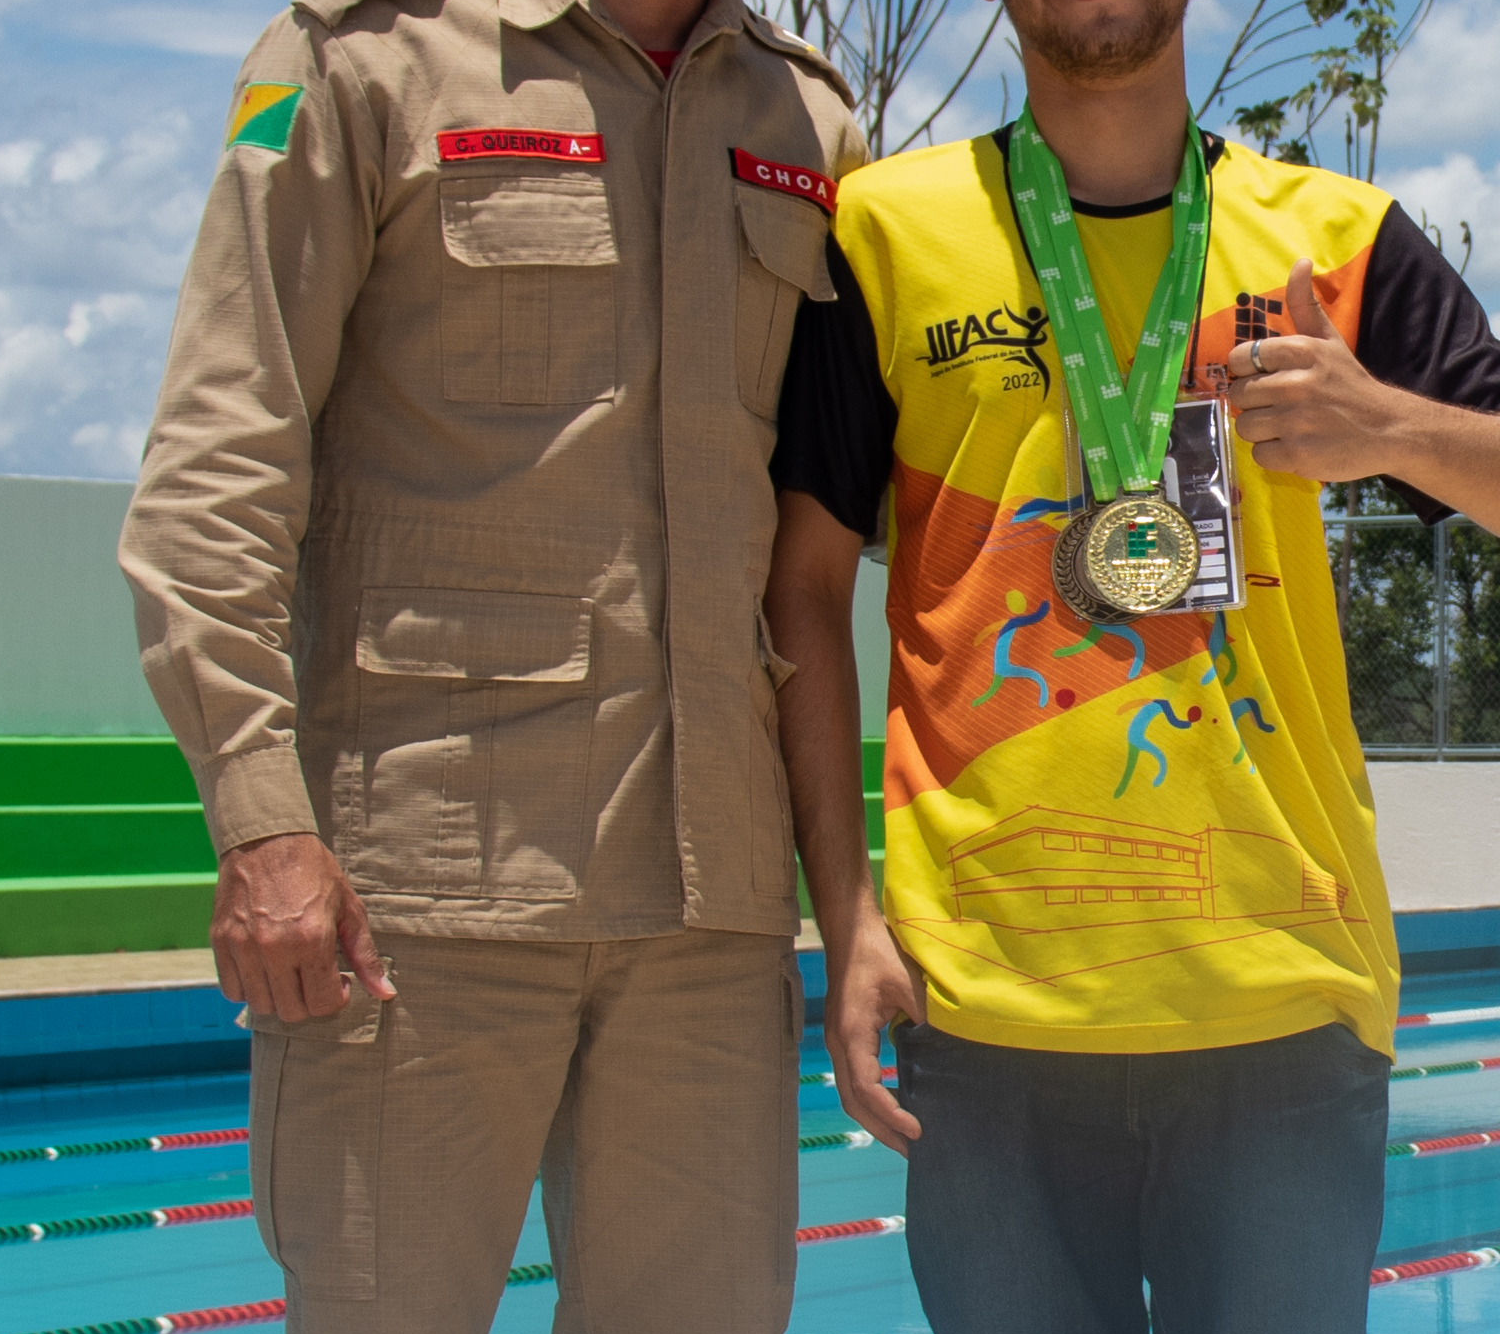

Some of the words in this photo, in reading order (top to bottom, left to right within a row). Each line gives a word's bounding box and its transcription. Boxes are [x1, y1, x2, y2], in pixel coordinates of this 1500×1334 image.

[455, 137, 475, 152] C.
[482, 134, 562, 153] QUEIROZ
[569, 139, 591, 155] A-
[756, 164, 827, 199] CHOA
[925, 308, 1008, 366] JIFAC
[951, 358, 975, 370] Instituto
[975, 353, 998, 362] Federal
[1001, 371, 1040, 391] 2022
[1195, 522, 1214, 530] RADO
